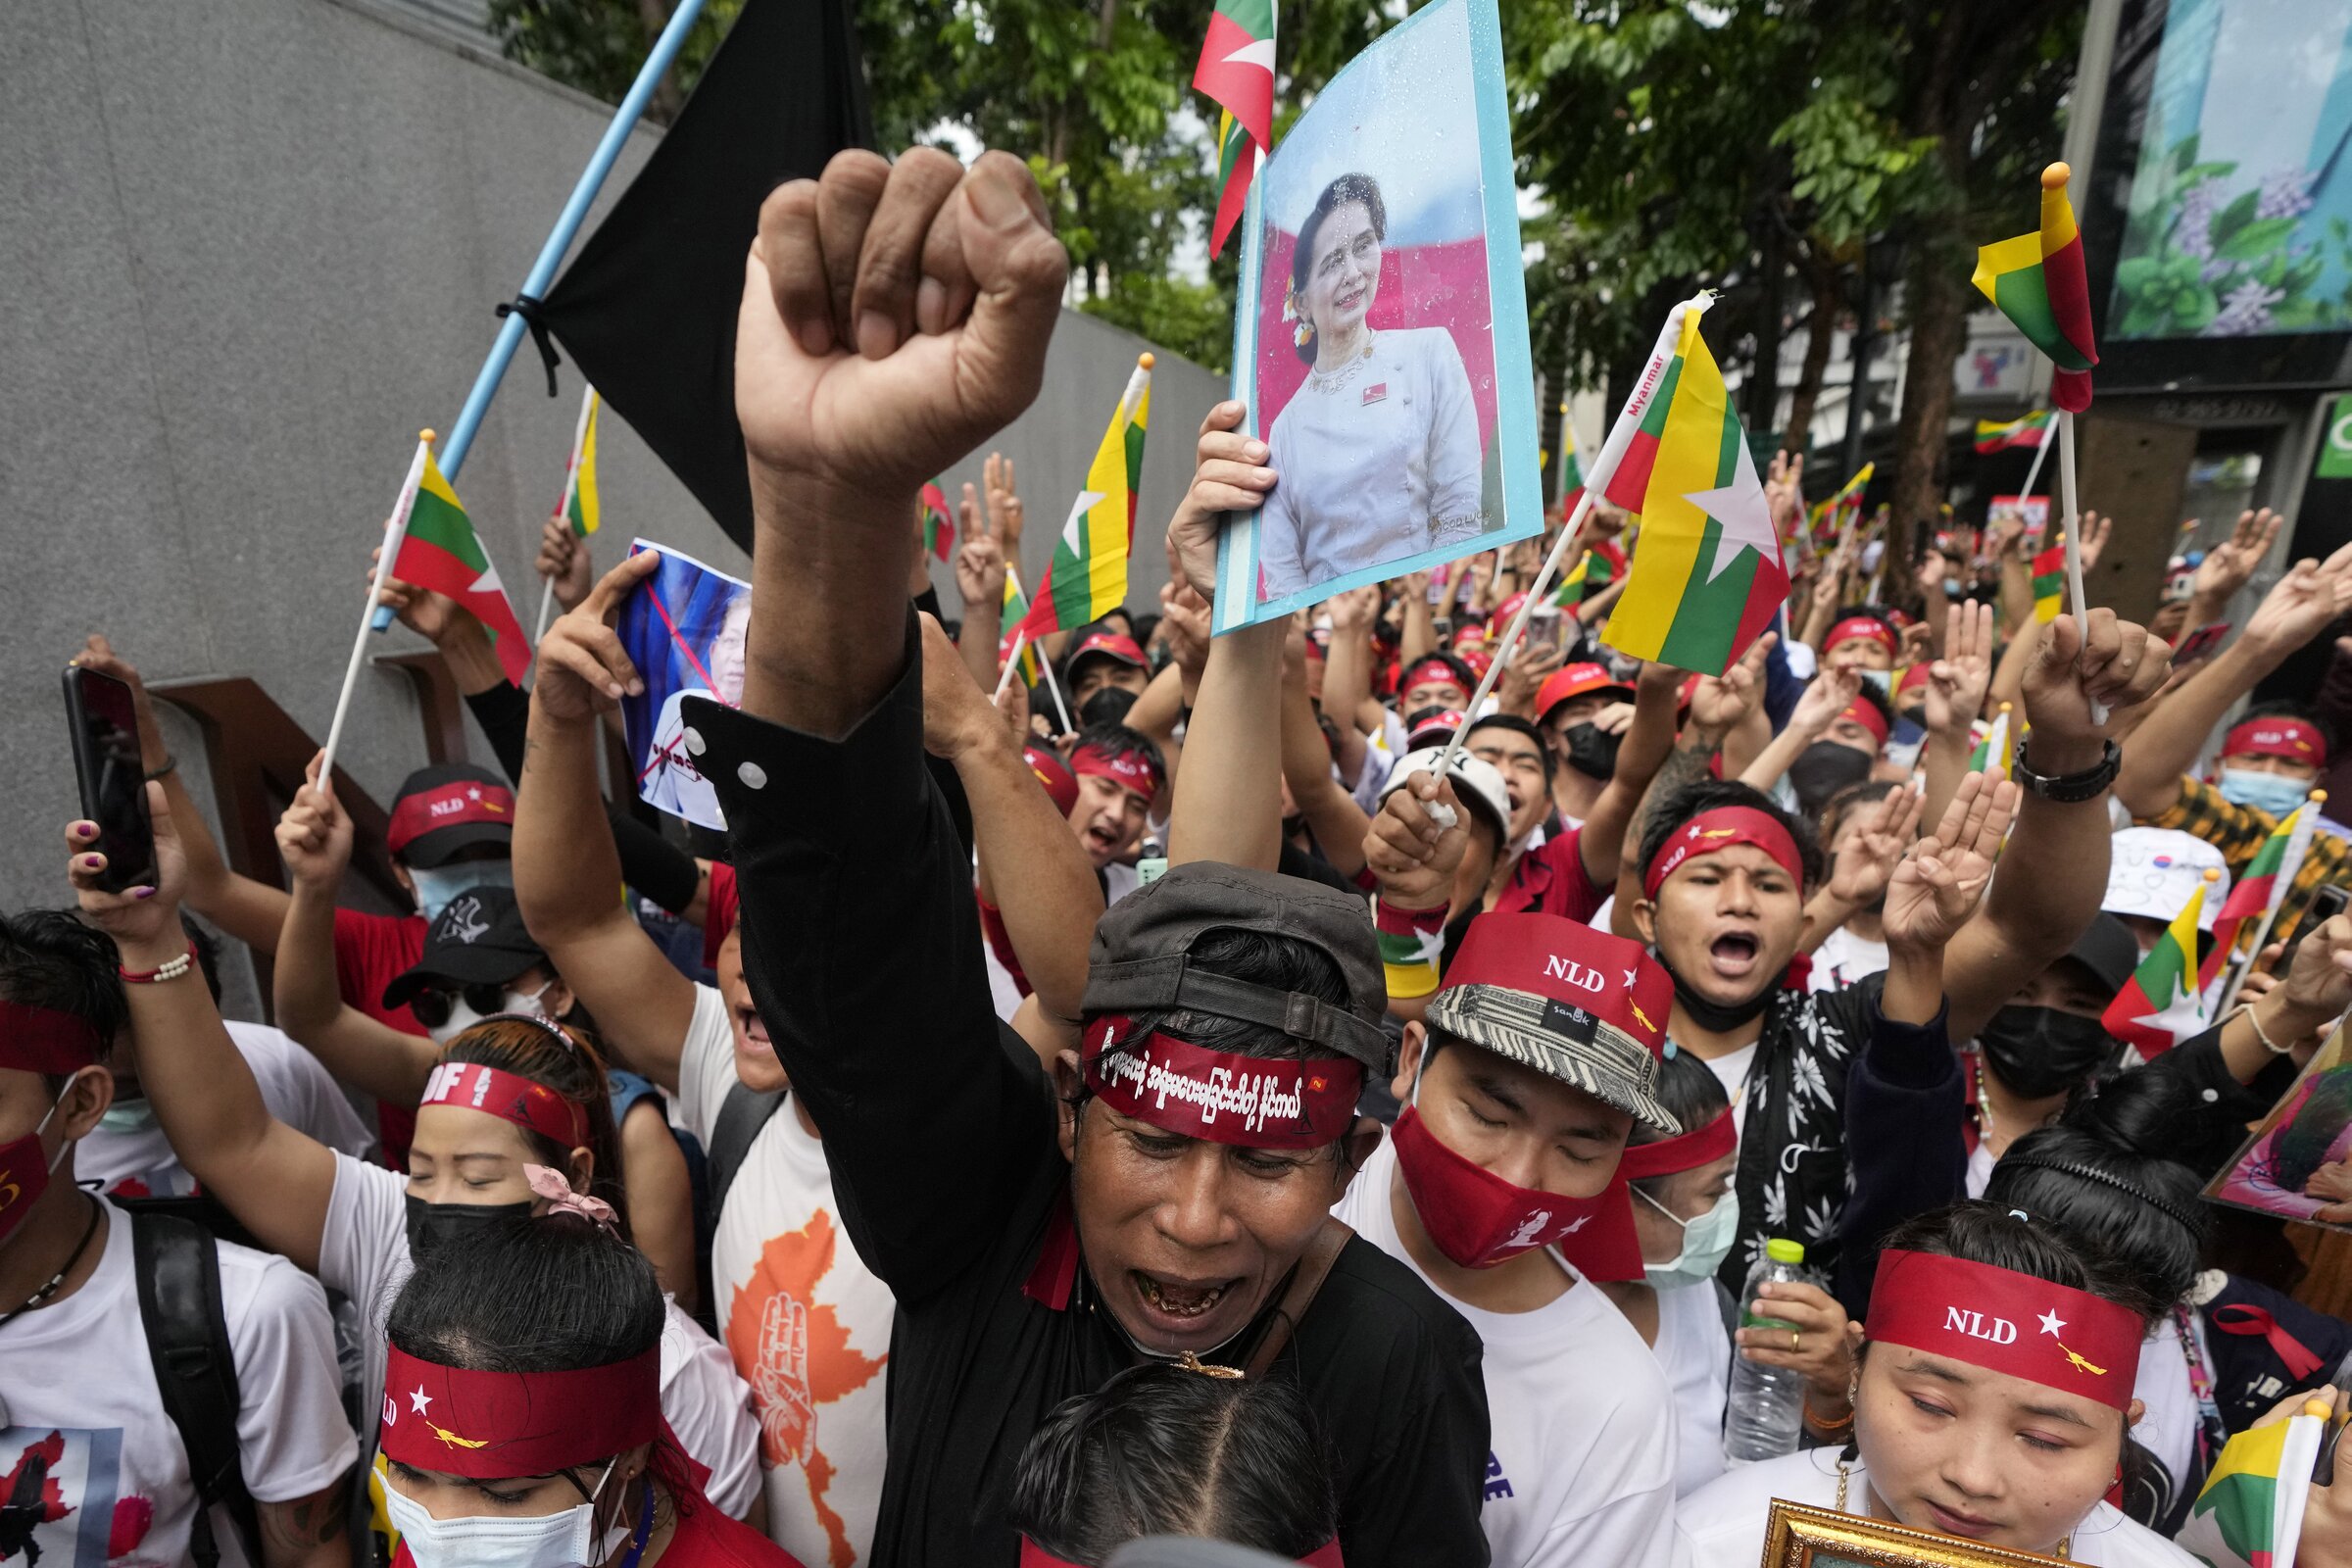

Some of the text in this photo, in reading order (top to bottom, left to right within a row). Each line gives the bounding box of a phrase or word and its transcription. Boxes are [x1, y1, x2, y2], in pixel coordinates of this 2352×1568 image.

[1628, 354, 1664, 416] Myanmar
[430, 797, 465, 817] NLD
[1543, 954, 1605, 993] NLD
[1943, 1305, 2017, 1345] NLD
[383, 1392, 397, 1427] LD
